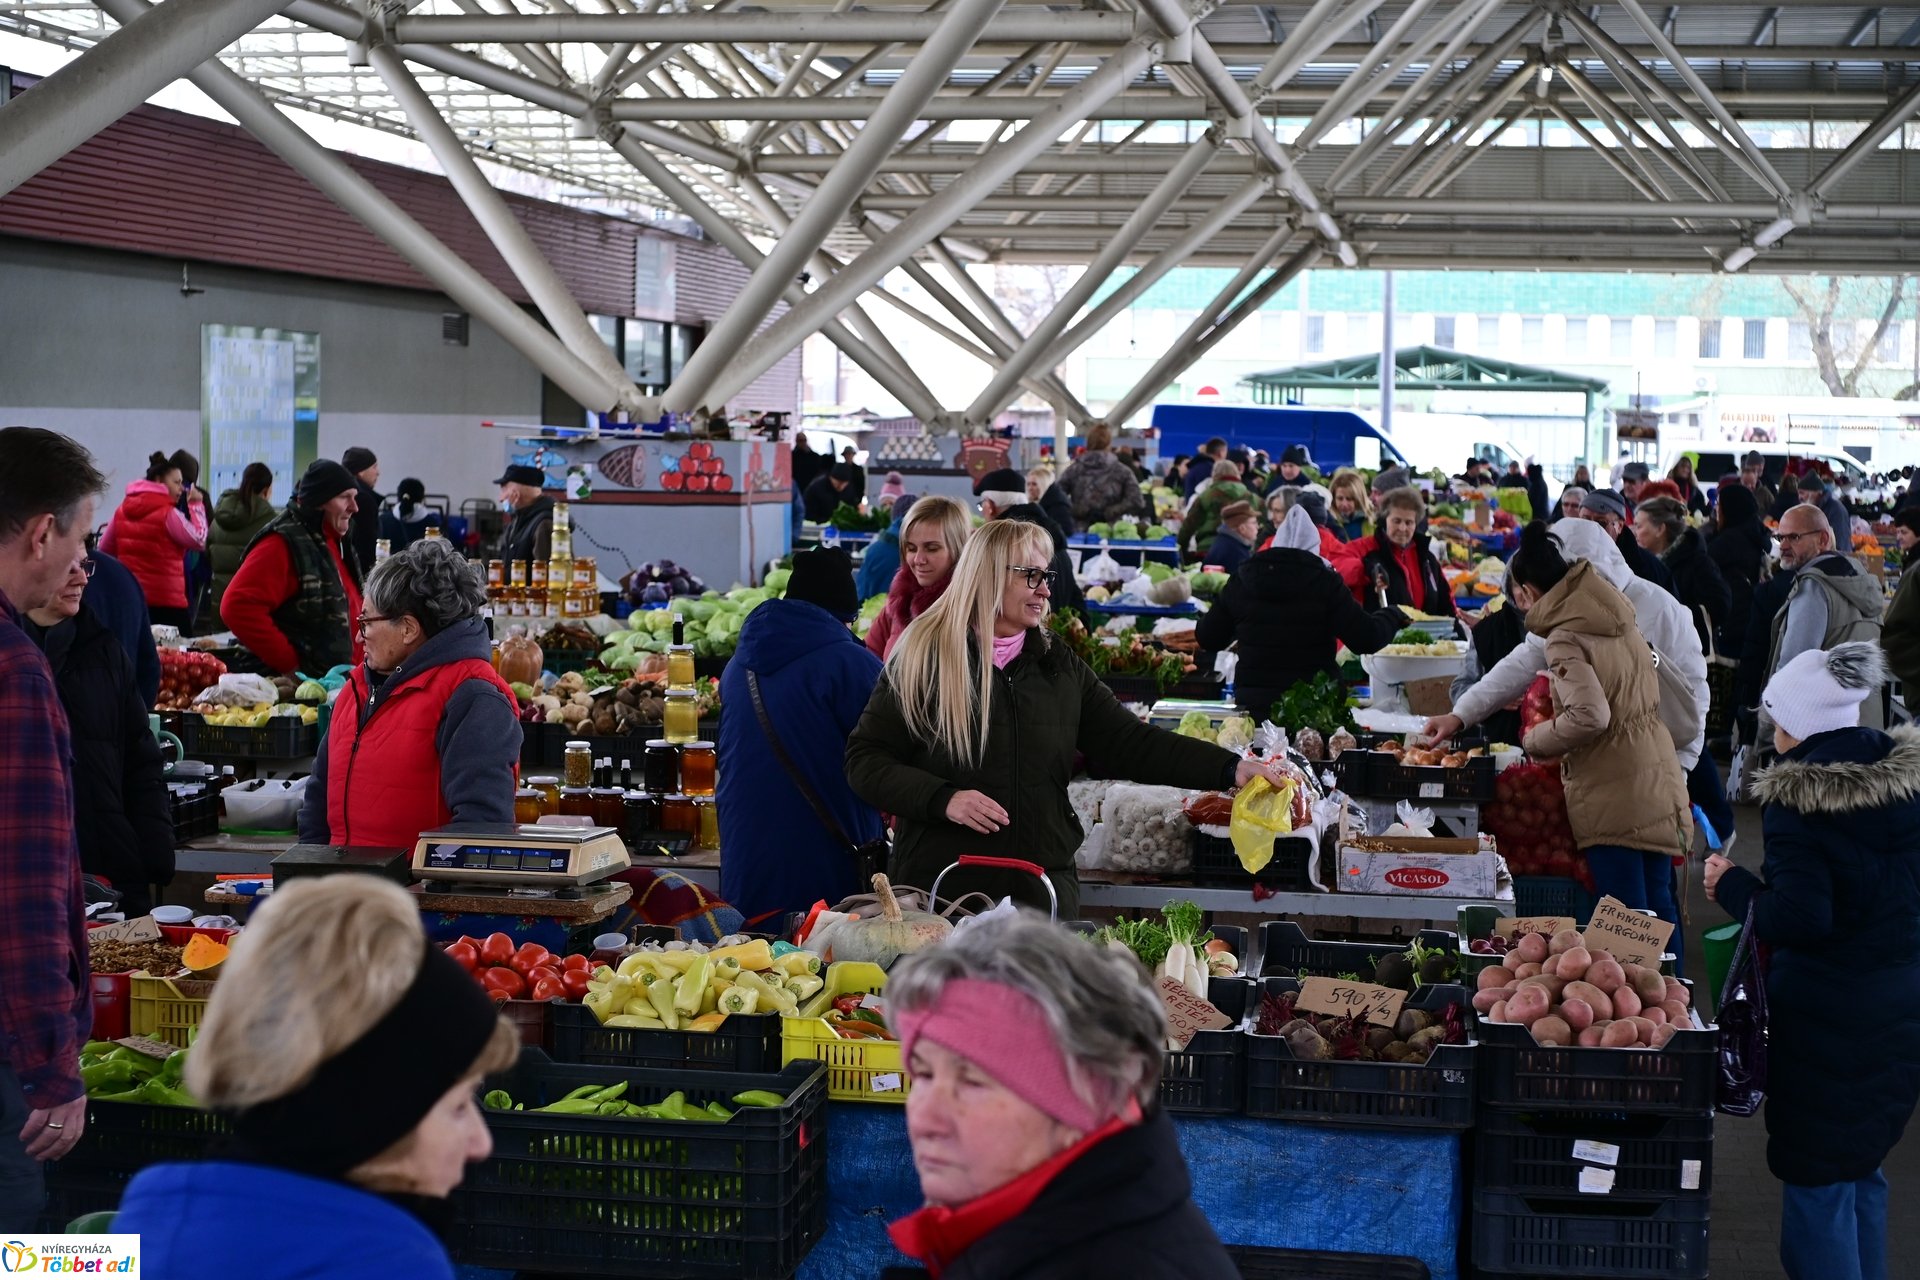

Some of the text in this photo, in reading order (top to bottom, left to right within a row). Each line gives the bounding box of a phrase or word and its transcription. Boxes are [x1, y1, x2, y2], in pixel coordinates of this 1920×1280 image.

[1389, 872, 1445, 884] VICASOL
[1600, 904, 1652, 929] FRANCIA
[1594, 918, 1660, 947] BURGONYA
[1162, 980, 1216, 1014] JÉGCSAP
[1325, 987, 1366, 1005] 590
[1166, 995, 1212, 1025] RETEK
